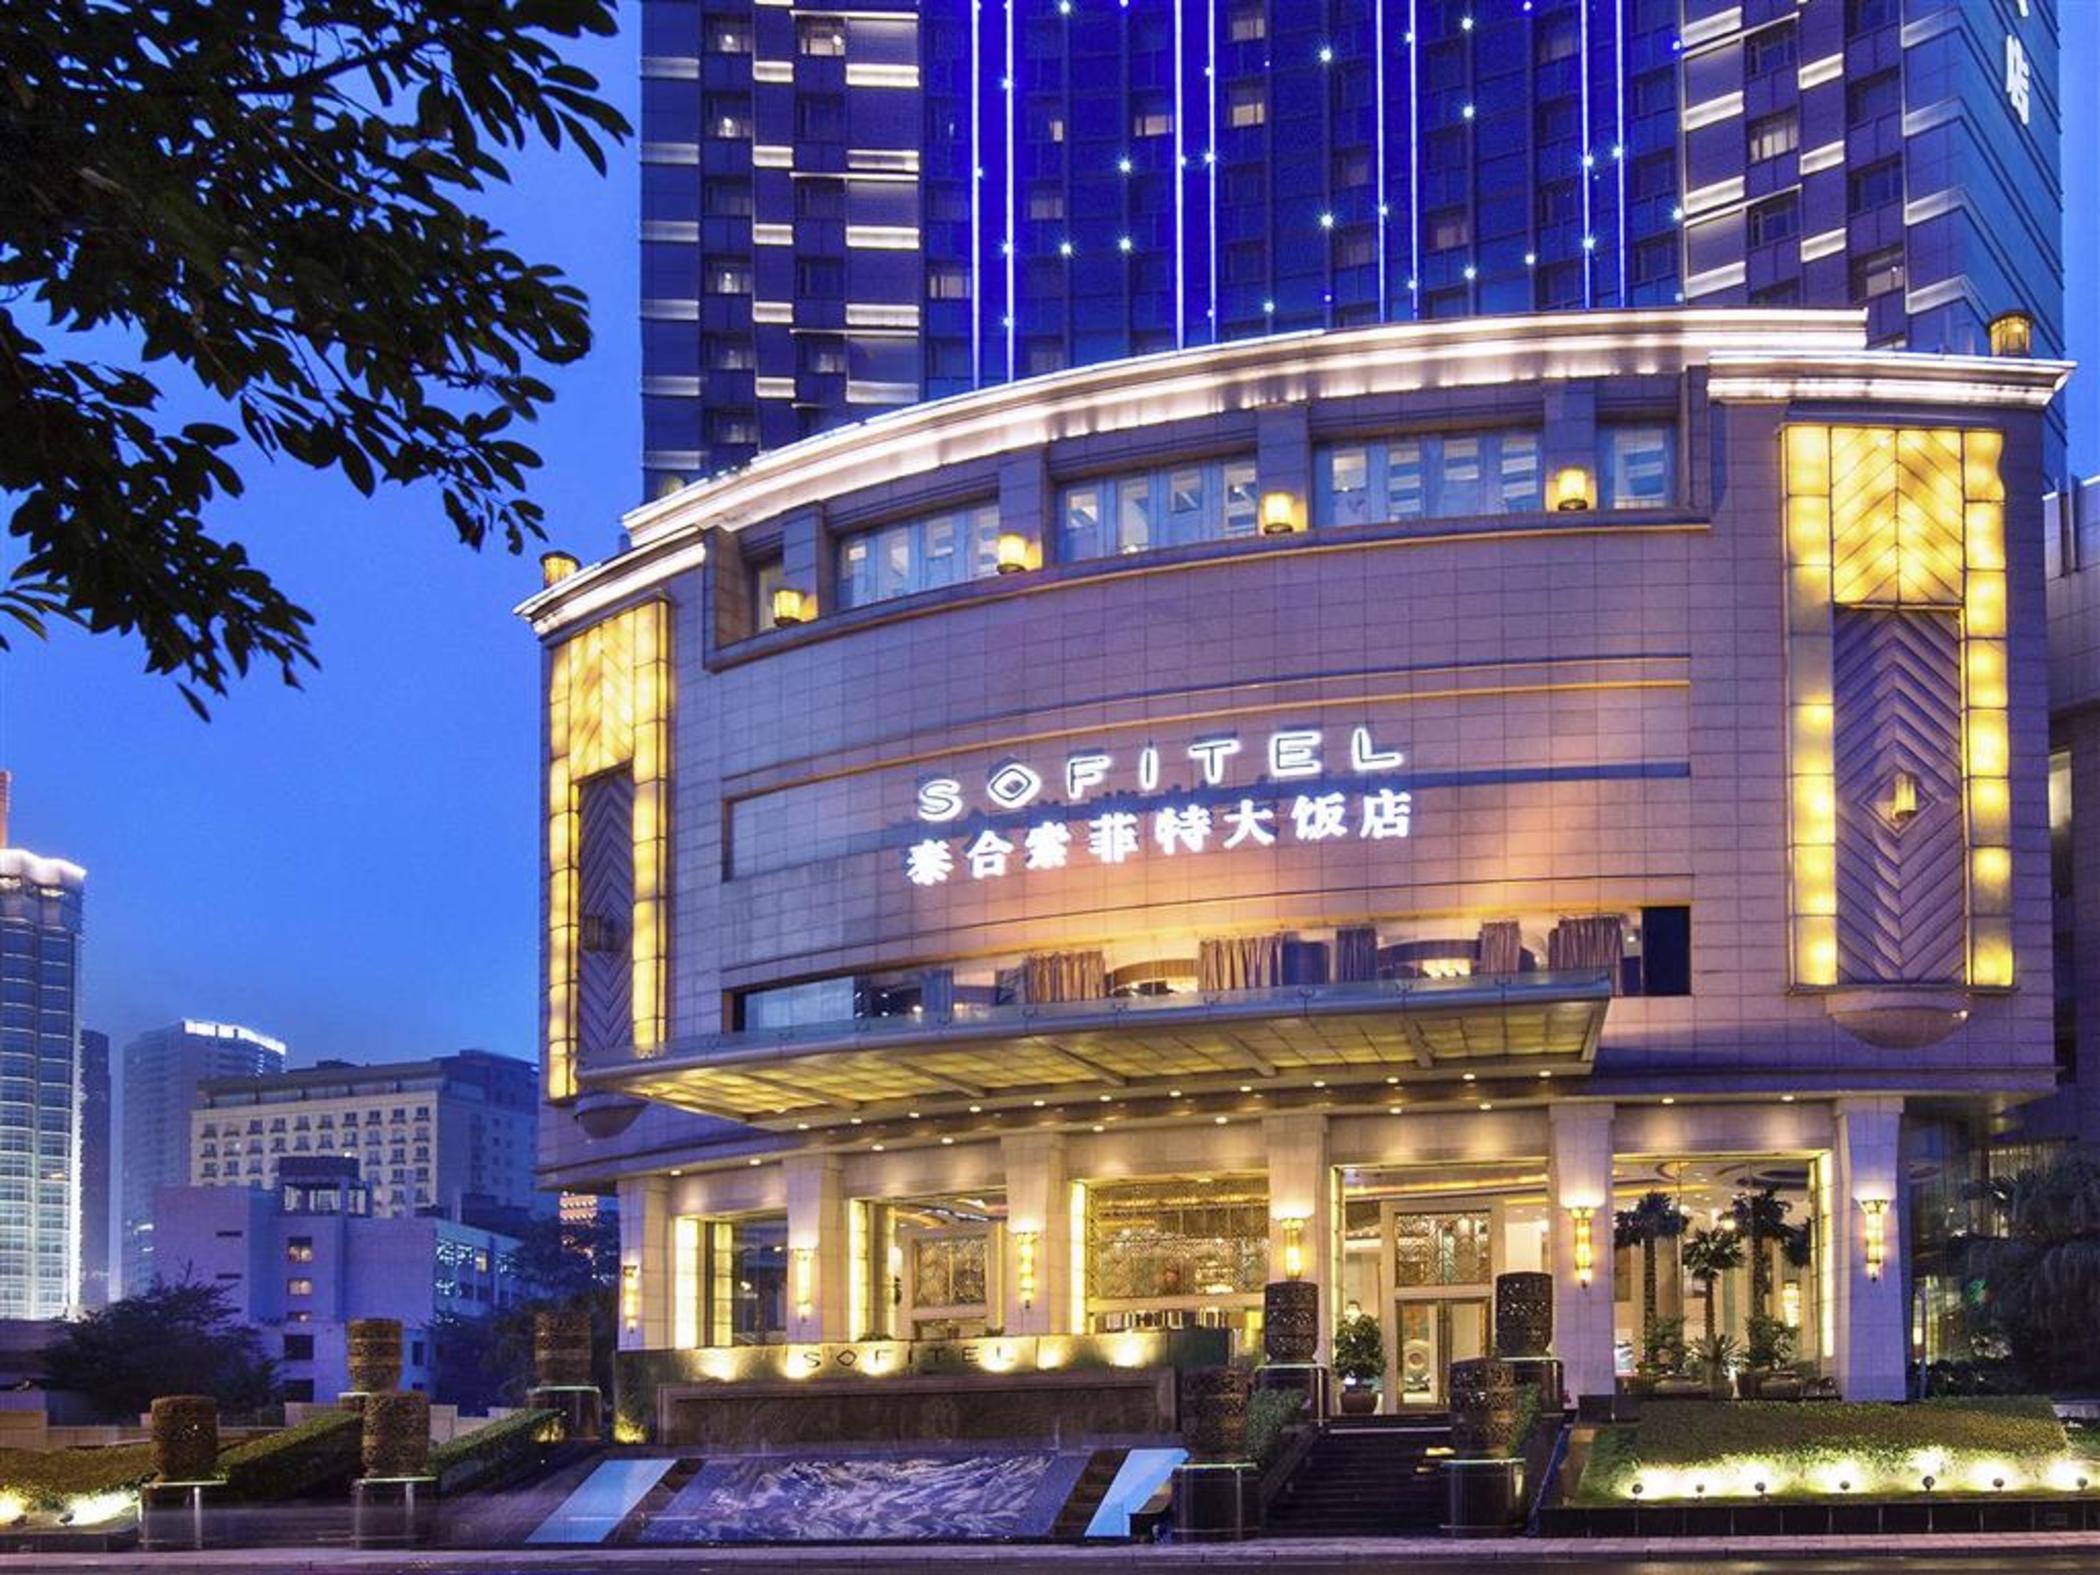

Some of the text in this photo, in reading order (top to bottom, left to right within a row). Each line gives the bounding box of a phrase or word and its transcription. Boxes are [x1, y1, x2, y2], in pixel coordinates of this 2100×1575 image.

[918, 728, 1402, 821] SOFITEL
[907, 790, 1411, 885] 泰合索菲特大饭店
[803, 1346, 1015, 1368] SOFITEL
